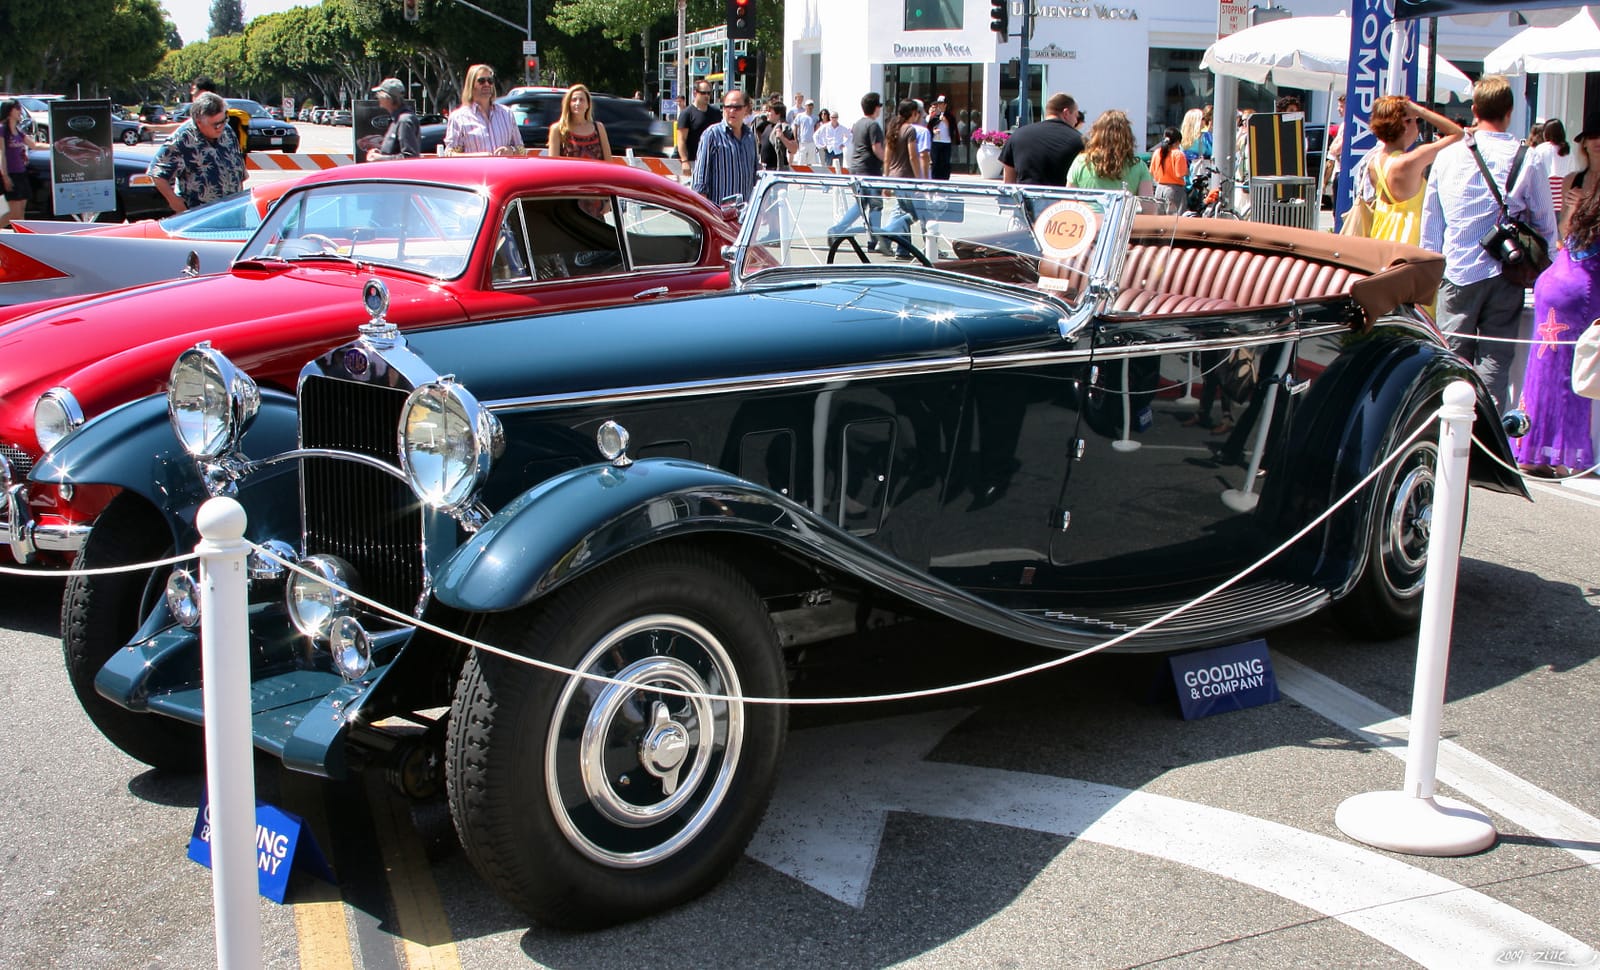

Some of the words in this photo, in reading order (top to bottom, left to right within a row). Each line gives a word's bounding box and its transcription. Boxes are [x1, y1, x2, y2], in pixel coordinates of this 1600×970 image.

[1094, 4, 1138, 20] VACCA
[1222, 5, 1247, 15] STOPPING
[893, 43, 942, 55] DOMENICO
[1045, 219, 1085, 239] MC-21
[1184, 658, 1264, 687] GOODING
[1190, 688, 1201, 700] &
[1202, 674, 1264, 697] COMPANY
